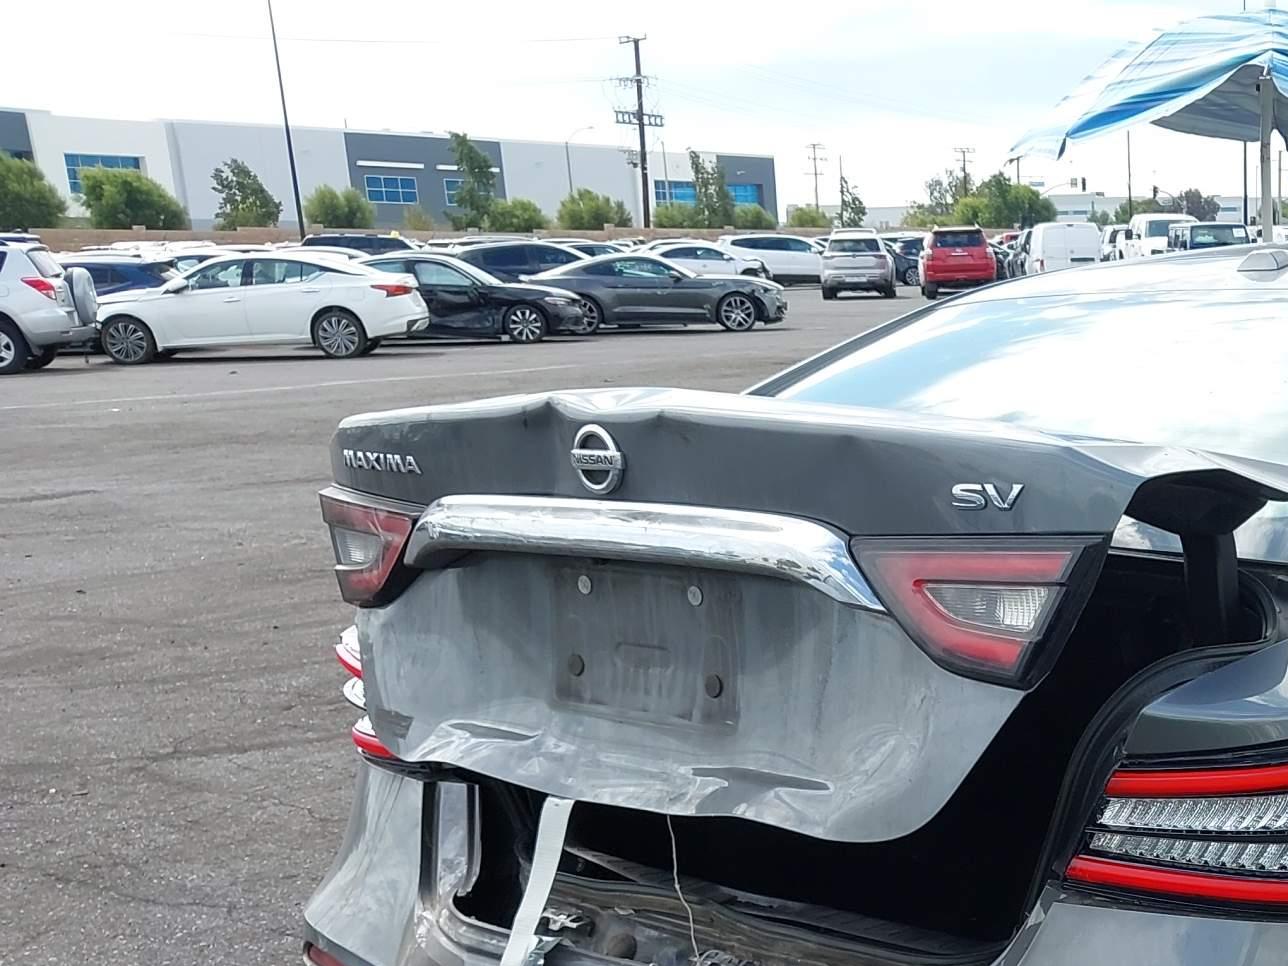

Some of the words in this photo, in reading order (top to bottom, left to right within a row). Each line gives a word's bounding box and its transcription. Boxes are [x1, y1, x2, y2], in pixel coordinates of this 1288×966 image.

[343, 449, 422, 474] MAXIMA
[573, 453, 613, 466] NISSAN
[951, 483, 1024, 511] SV
